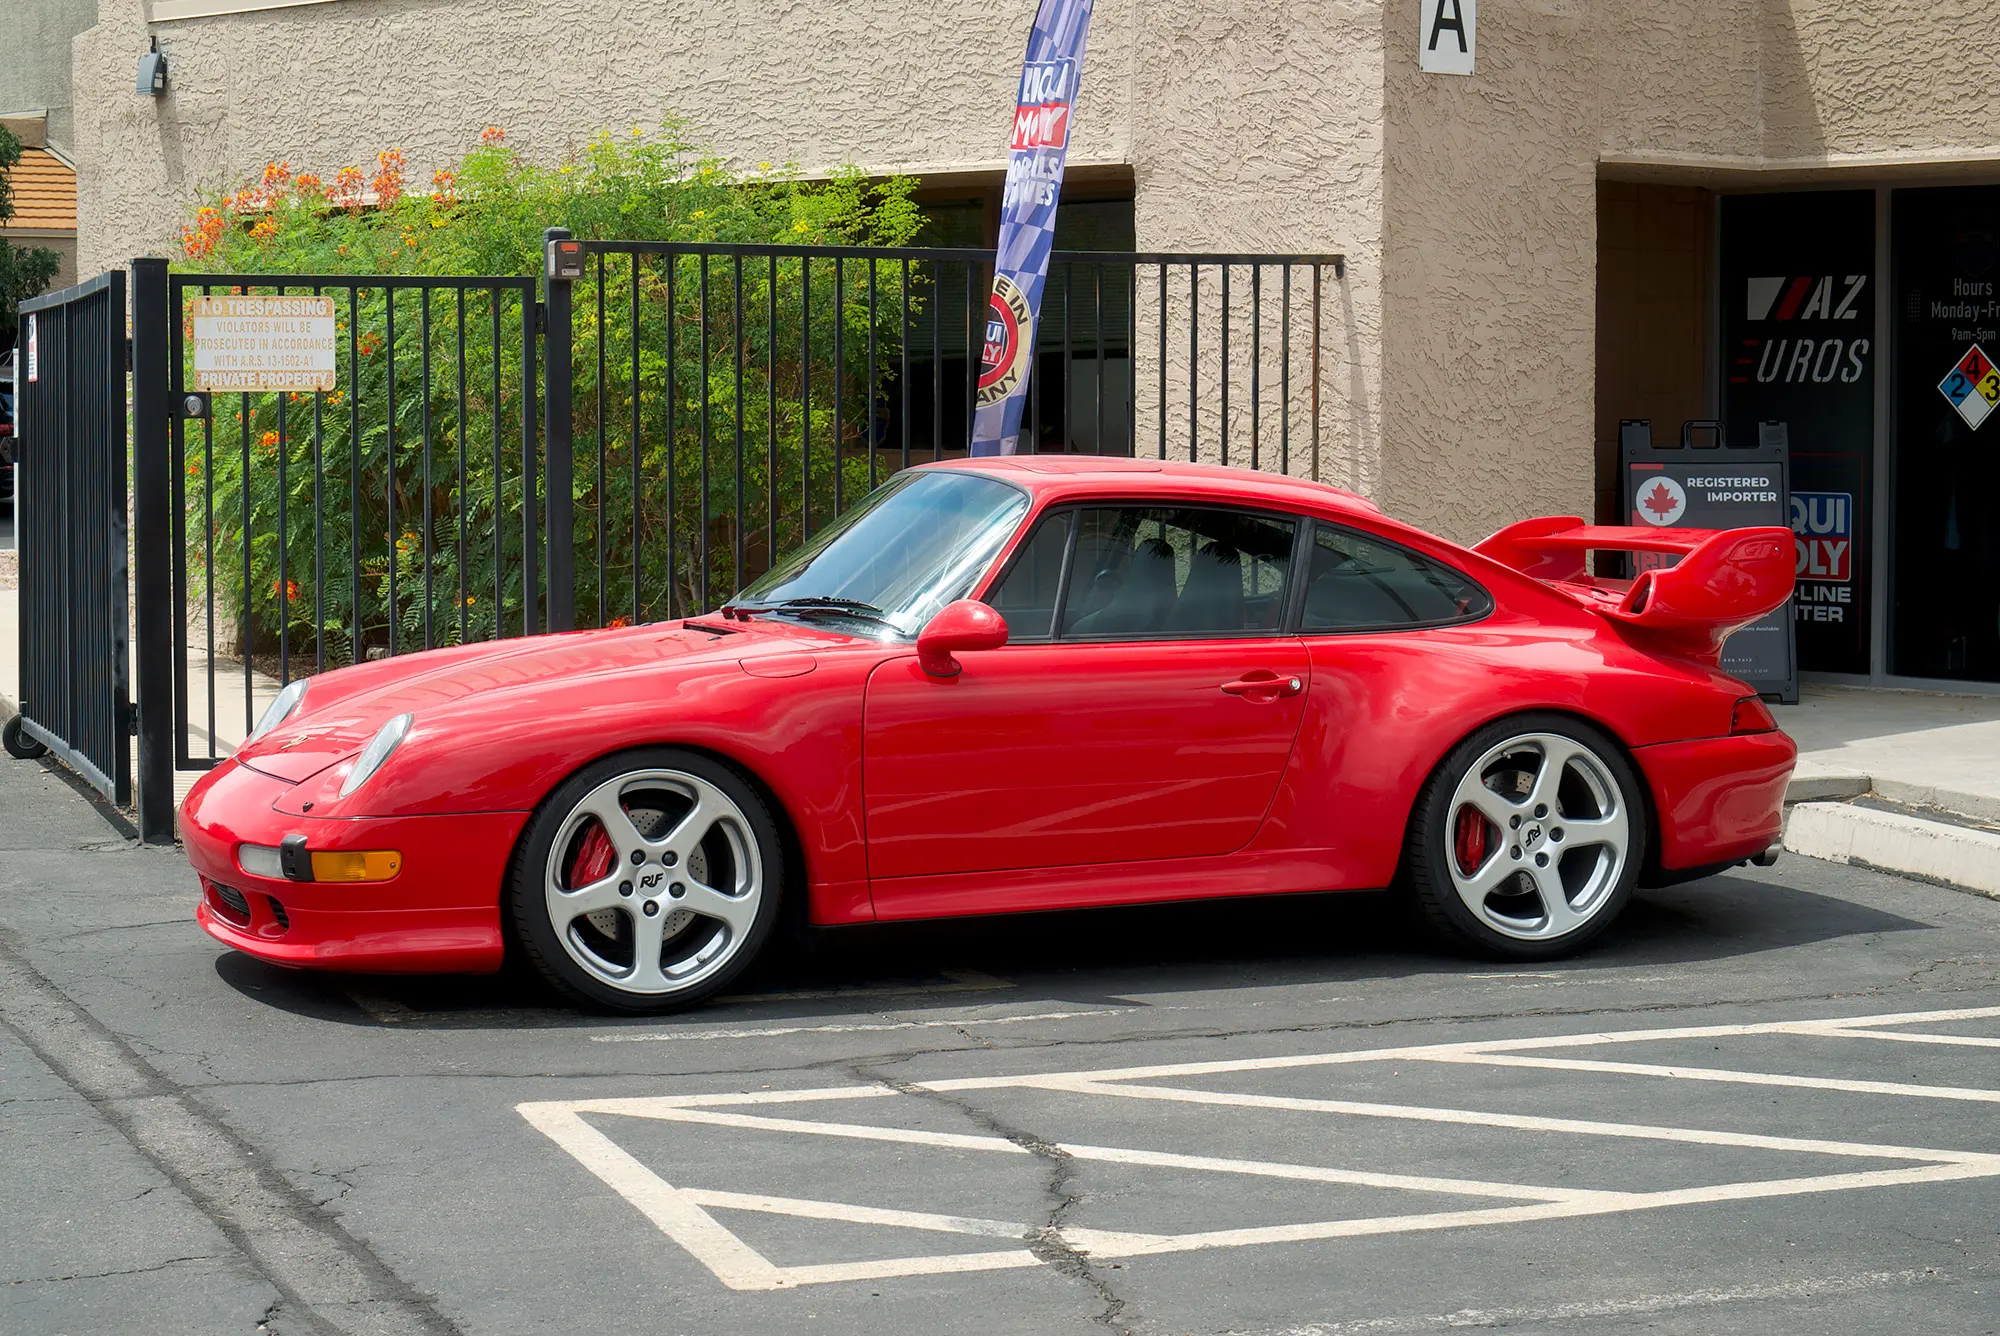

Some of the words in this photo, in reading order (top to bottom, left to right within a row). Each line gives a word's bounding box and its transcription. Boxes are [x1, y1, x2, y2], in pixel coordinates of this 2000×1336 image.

[1428, 0, 1468, 53] A
[1953, 279, 1993, 296] Hours
[201, 301, 223, 315] NO
[227, 301, 327, 315] TRESPASSING
[1931, 300, 2000, 322] Monday-Fr
[217, 322, 270, 333] VIOLATORS
[273, 322, 296, 333] WILL
[299, 322, 312, 333] BE
[1951, 328, 1996, 343] 9am-5pm
[195, 338, 256, 349] PROSECUTED
[259, 338, 269, 349] IN
[272, 338, 333, 349] ACCORDANCE
[214, 355, 237, 366] WITH
[240, 355, 264, 366] A.R.S.
[267, 355, 314, 366] 13-1502-A1
[1730, 339, 1869, 383] EUROS
[1966, 355, 1980, 380] 4
[201, 373, 256, 385] PRIVATE
[260, 373, 327, 385] PROPERTY
[1950, 374, 1965, 398] 2
[1985, 375, 2000, 401] 3
[1687, 477, 1770, 488] REGISTERED
[1707, 491, 1777, 502] IMPORTER
[1791, 497, 1845, 535] QUI
